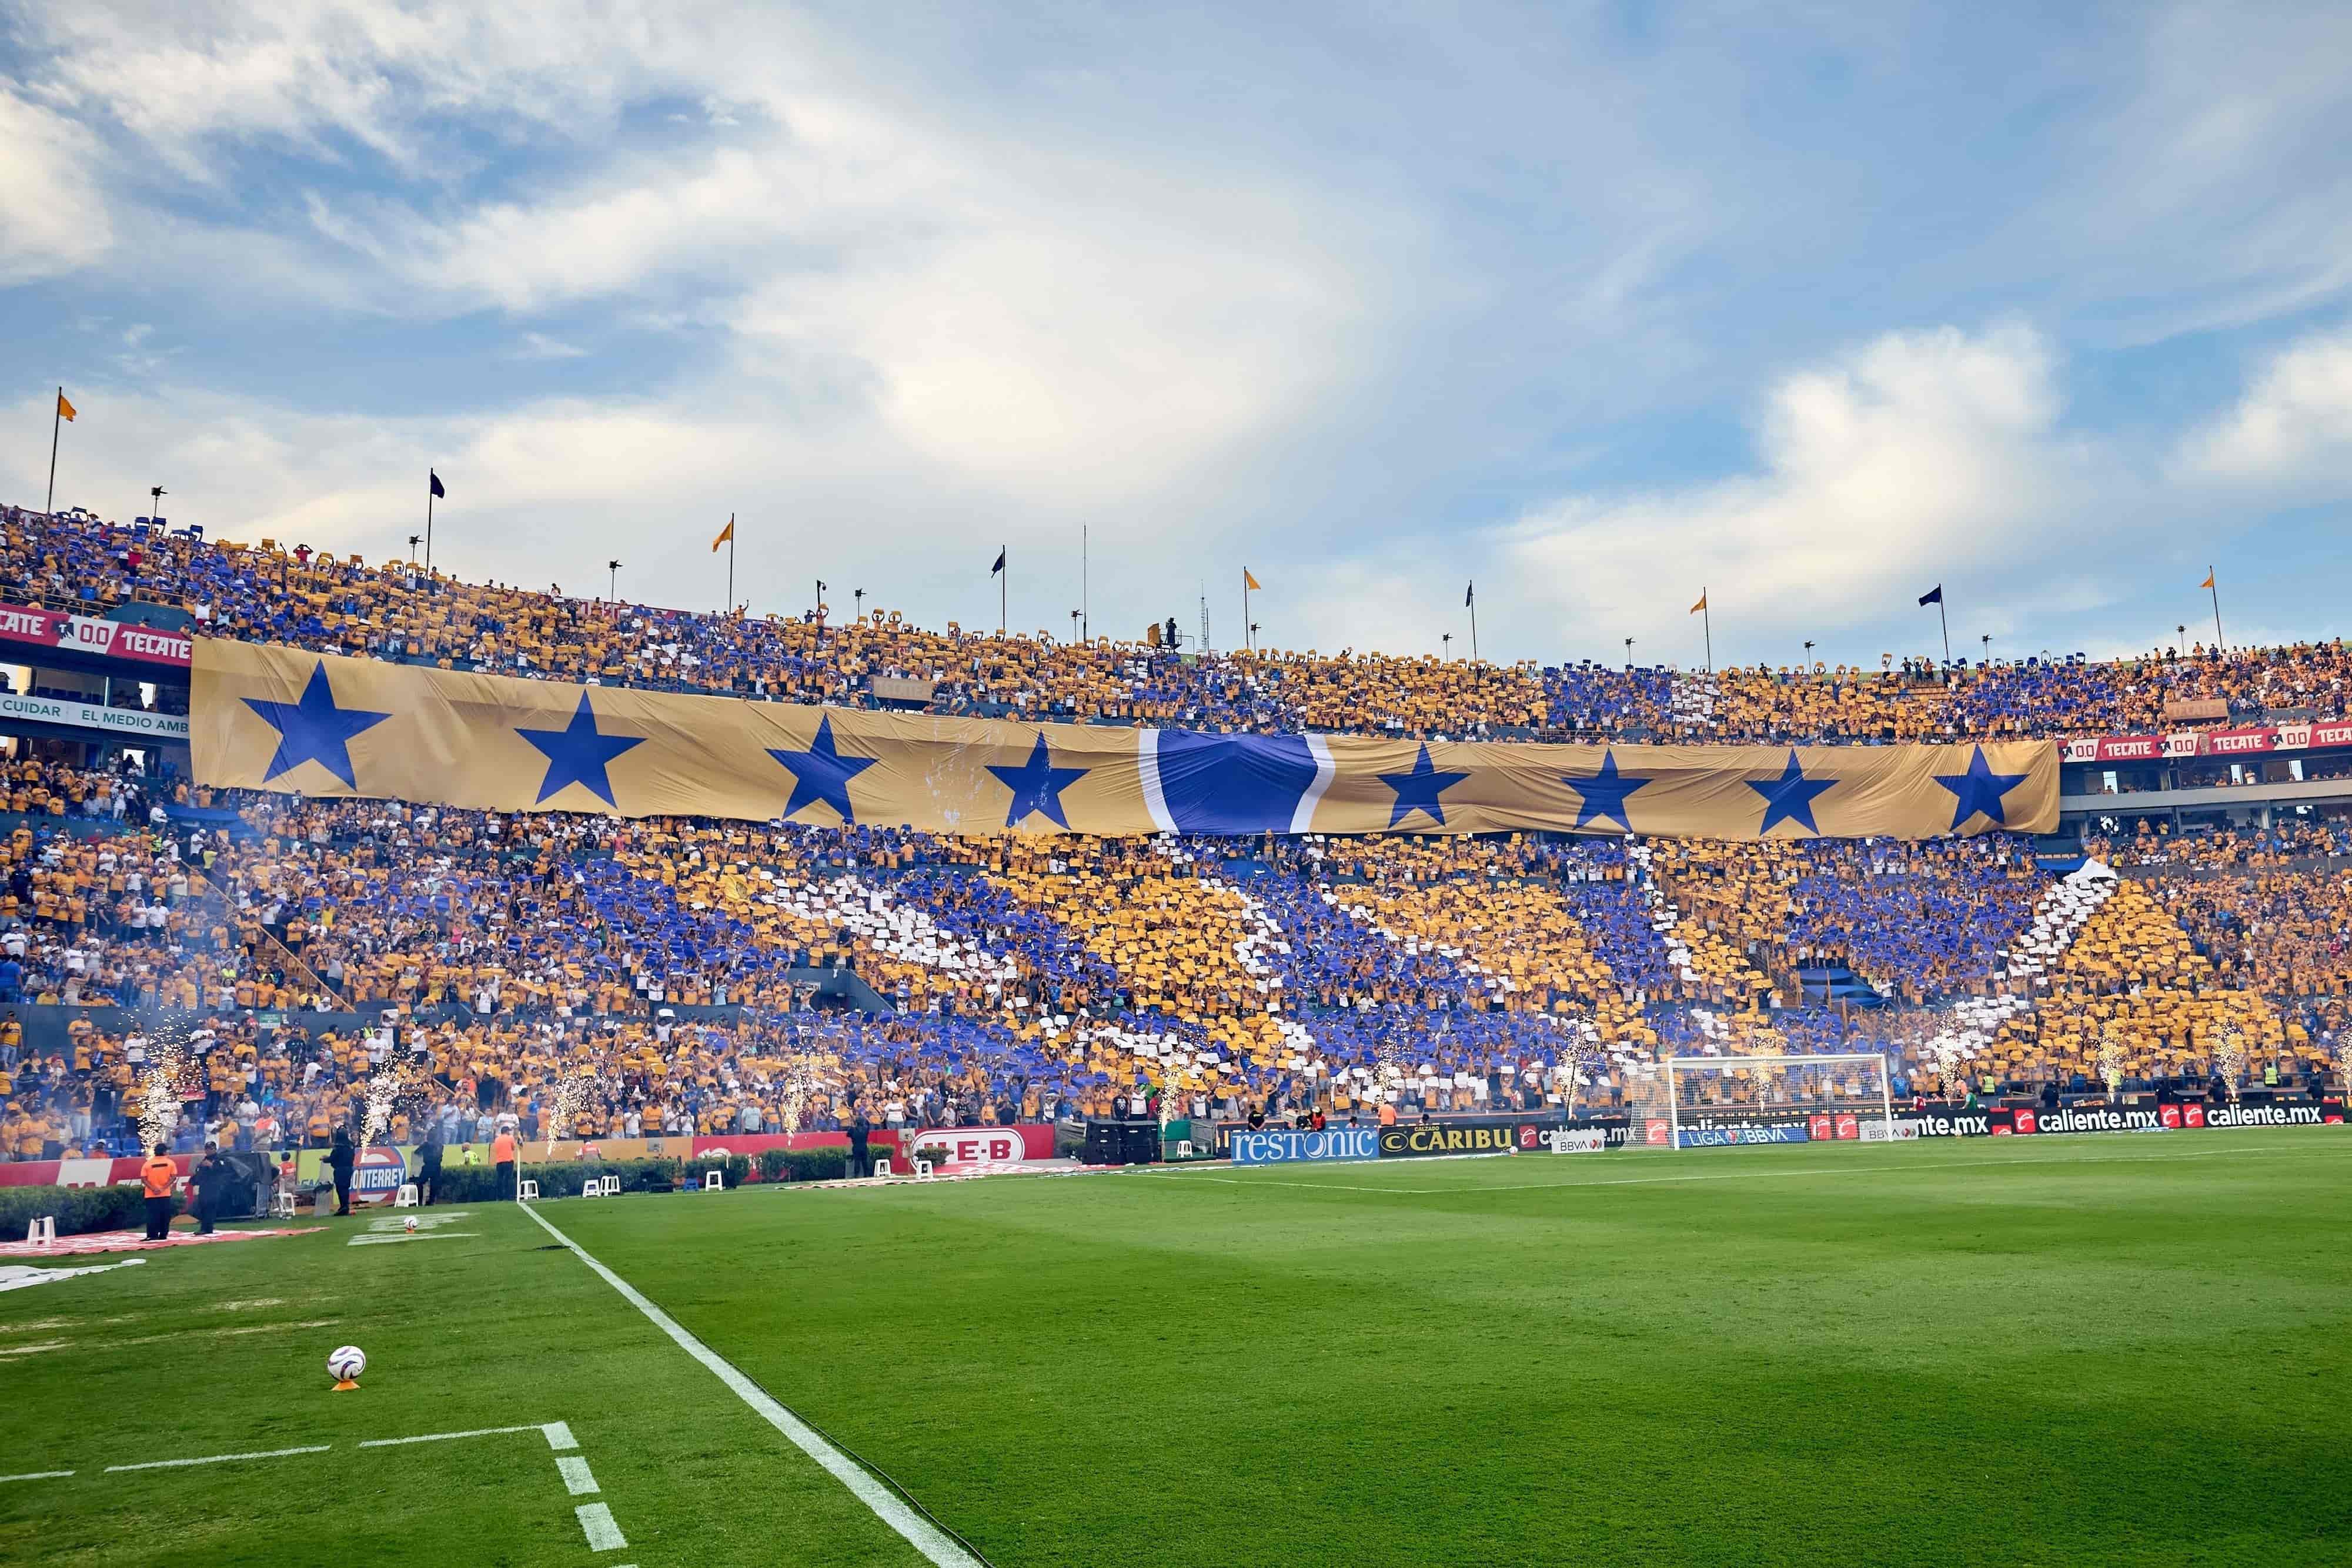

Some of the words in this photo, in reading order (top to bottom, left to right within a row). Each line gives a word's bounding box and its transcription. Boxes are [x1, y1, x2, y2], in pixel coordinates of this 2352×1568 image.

[80, 624, 110, 646] 0.0
[121, 630, 191, 659] TECATE
[3, 700, 61, 717] CUIDAR
[82, 710, 98, 721] EL
[103, 712, 152, 728] MEDIO
[2076, 745, 2094, 758] 0.0
[2104, 741, 2152, 757] TECATE
[2174, 740, 2194, 753] 0.0
[2213, 734, 2263, 751] TECATE
[2287, 732, 2307, 745] 0.0
[2039, 1109, 2159, 1132] caliente.mx
[2207, 1104, 2321, 1126] caliente.mx
[1409, 1129, 1512, 1151] CARIBU
[1561, 1139, 1588, 1151] BBVA
[1688, 1132, 1725, 1146] LIGA
[1745, 1128, 1788, 1143] BBVA
[348, 1168, 405, 1189] ONTERREY
